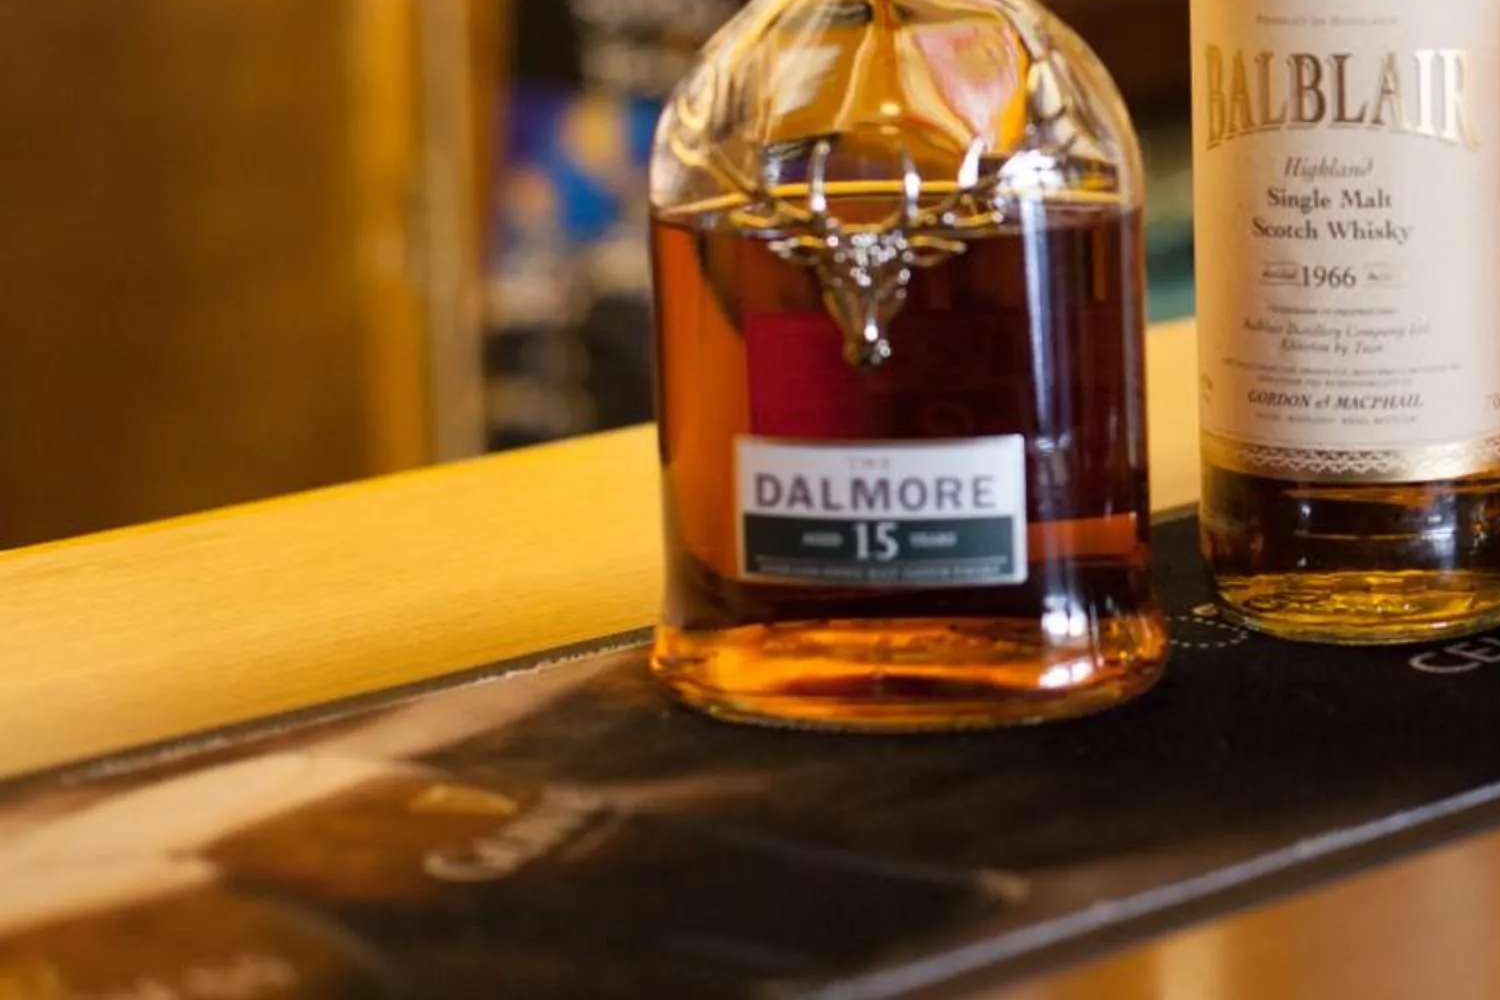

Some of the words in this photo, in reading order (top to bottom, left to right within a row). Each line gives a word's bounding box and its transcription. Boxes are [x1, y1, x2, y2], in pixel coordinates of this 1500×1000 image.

[1205, 45, 1481, 152] BALBLAIR
[1284, 156, 1375, 186] Highland
[1266, 188, 1332, 214] Single
[1341, 188, 1392, 209] Malt
[1251, 217, 1319, 241] Scotch
[1327, 219, 1414, 245] Whisky
[1301, 264, 1357, 289] 1966
[755, 473, 997, 512] DALMORE
[854, 521, 899, 561] 15
